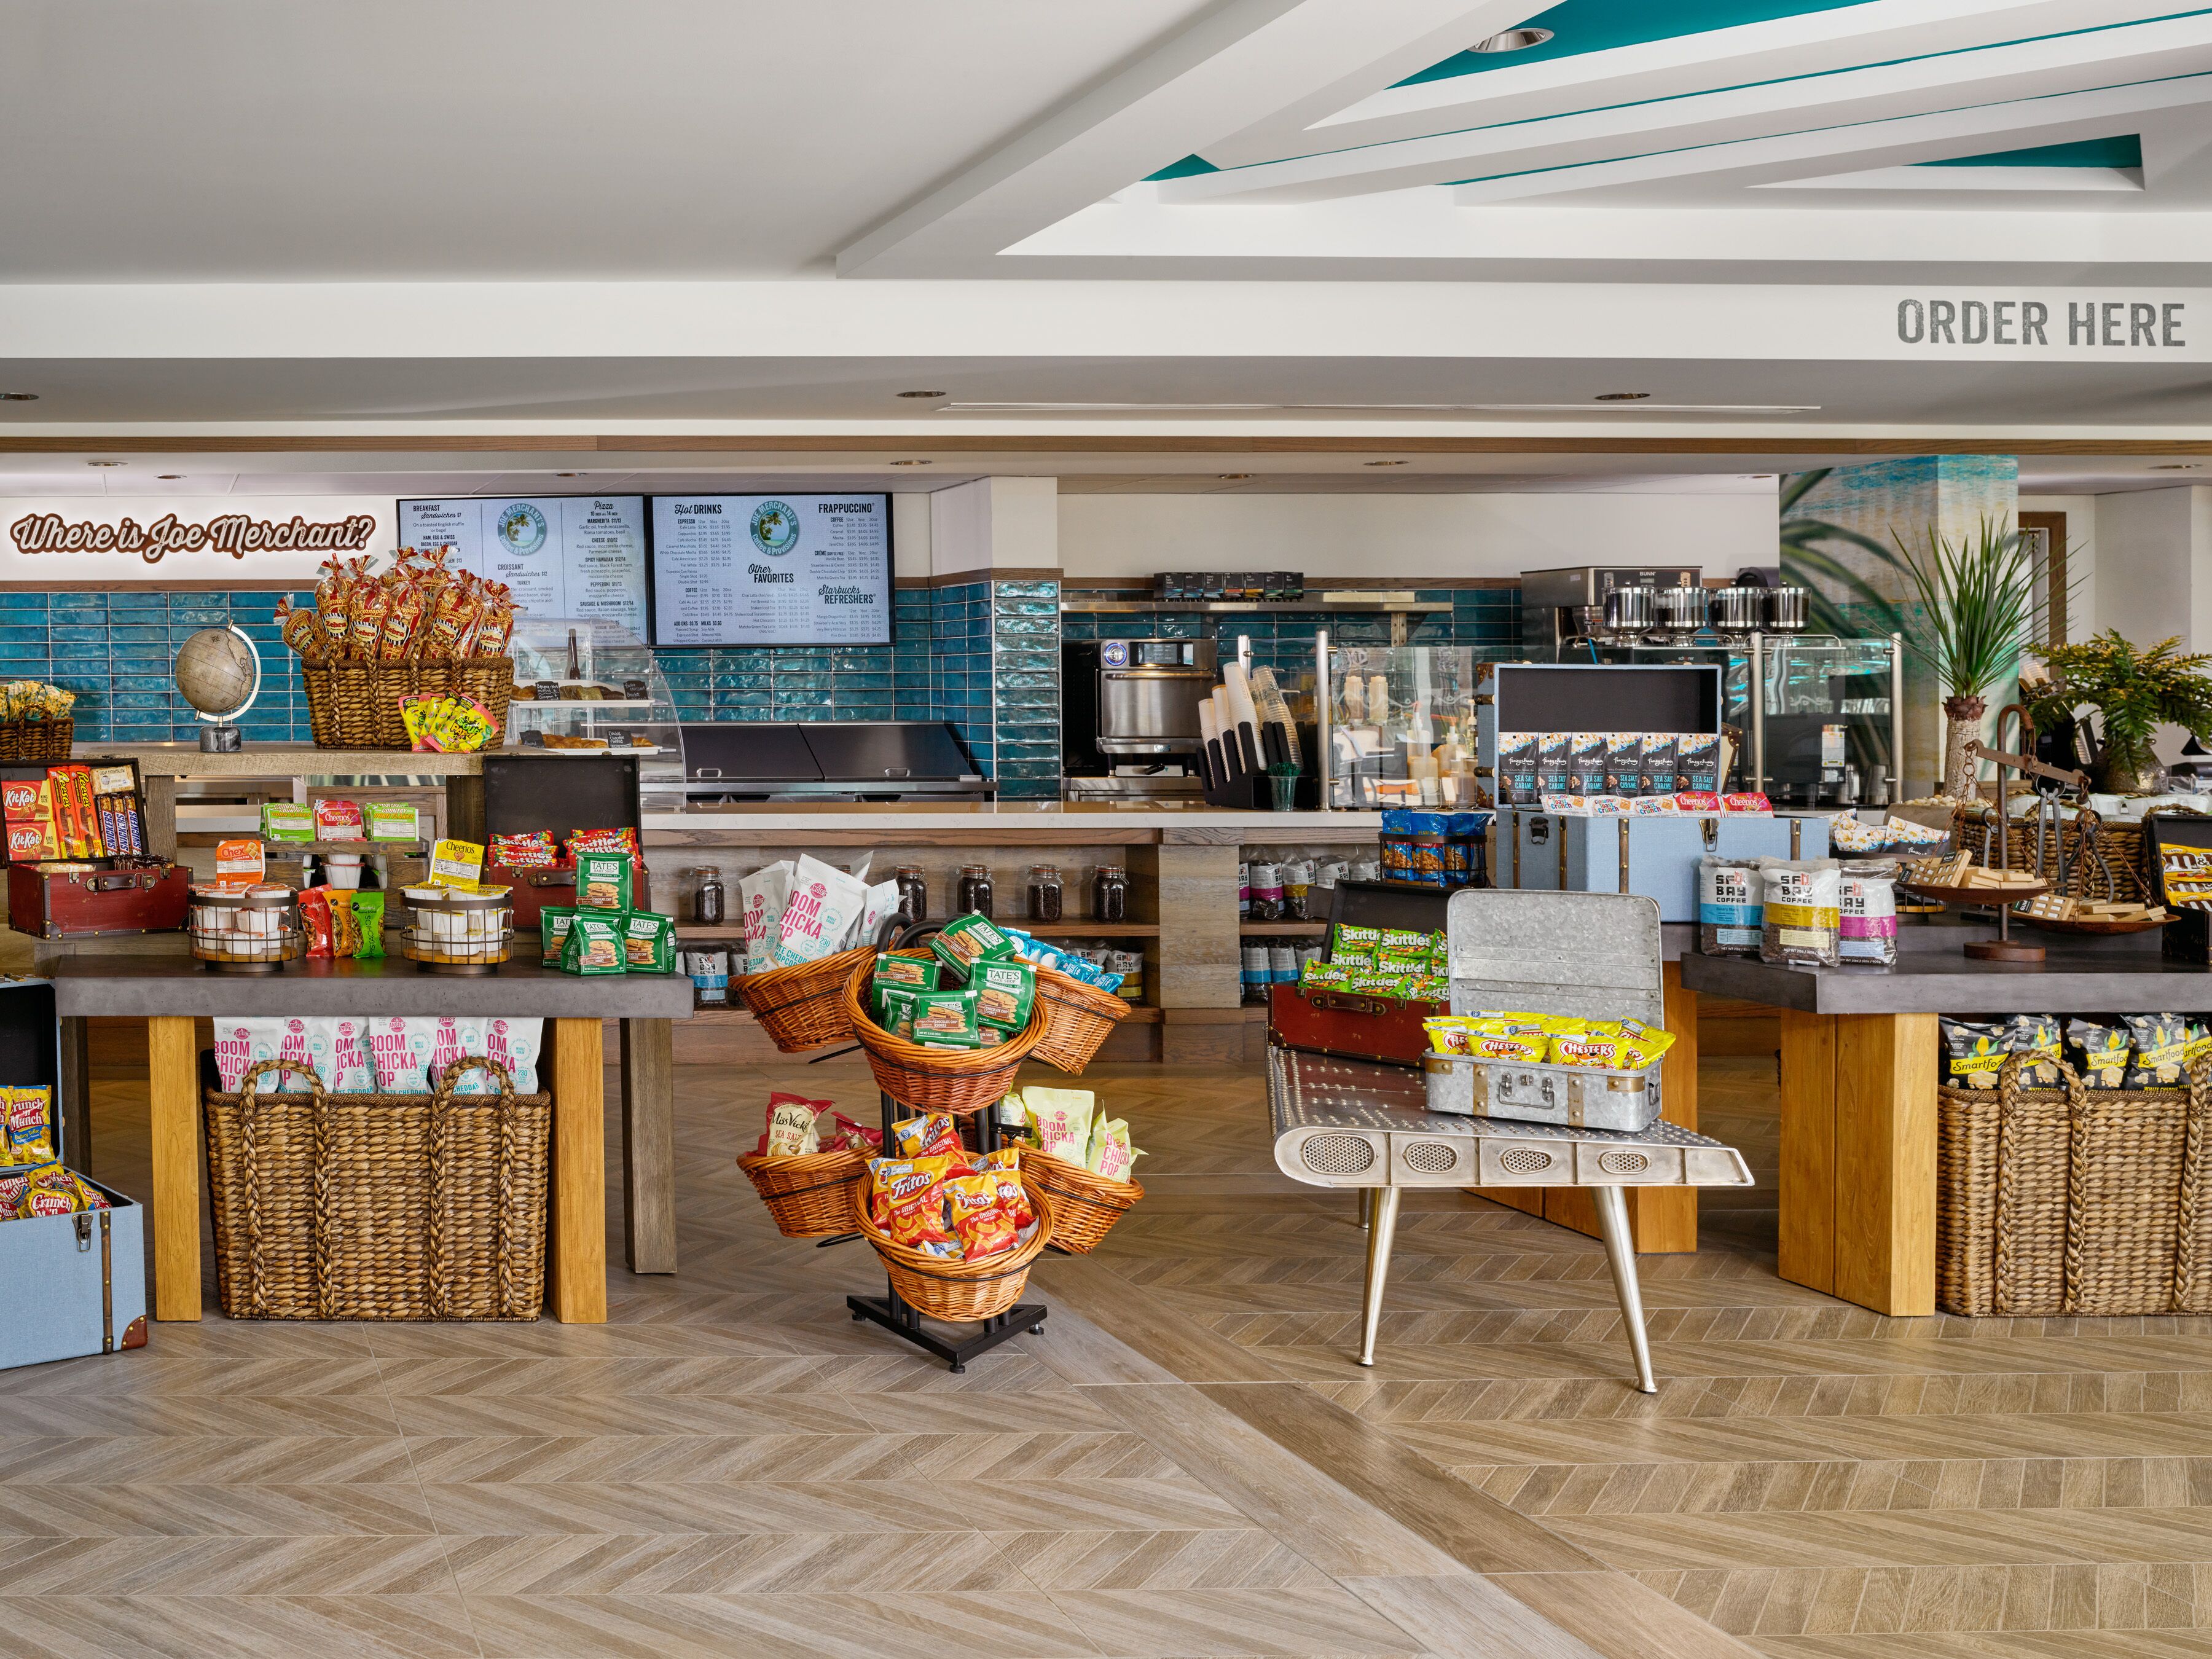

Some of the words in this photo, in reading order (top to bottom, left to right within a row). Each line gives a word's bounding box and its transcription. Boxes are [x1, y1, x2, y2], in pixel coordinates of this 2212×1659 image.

[1897, 298, 2049, 345] ORDER
[2068, 302, 2186, 347] HERE
[594, 501, 614, 509] Pizza
[675, 504, 693, 515] Hot
[694, 504, 722, 514] DRINKS
[498, 513, 508, 527] JOE
[506, 504, 544, 527] MERCHANT'S
[751, 512, 761, 526] JOE
[758, 501, 797, 527] MERCHANT'S
[14, 512, 114, 549] Where
[120, 517, 143, 549] is
[148, 514, 204, 560] Joe
[211, 515, 375, 555] Merchant?
[500, 535, 513, 552] Coffee
[519, 534, 544, 554] Provisions
[752, 534, 766, 552] Coffee
[772, 533, 796, 555] Provisions
[748, 563, 772, 574] Other
[754, 573, 794, 583] FAVORITES
[818, 584, 861, 597] Starbucks
[480, 634, 501, 644] Zebra
[104, 812, 116, 849] SNICKERS
[129, 811, 141, 849] SNICKERS
[222, 849, 245, 857] Chex
[446, 841, 475, 854] Cheerios
[1716, 875, 1735, 884] SF
[1781, 875, 1801, 884] SF
[1716, 886, 1746, 896] BAY
[365, 915, 375, 954] PISTACHIOS
[1381, 933, 1431, 947] Skittles
[989, 970, 1019, 979] TATE'S
[1560, 1041, 1617, 1058] CHESTER'S
[2143, 1046, 2184, 1065] Smartfood
[10, 1114, 43, 1130] Munch
[1037, 1116, 1066, 1131] BOOM
[15, 1131, 28, 1140] Buttery
[775, 1130, 784, 1139] SEA
[786, 1132, 801, 1140] SALT
[1100, 1160, 1119, 1177] POP
[891, 1173, 931, 1200] Fritos
[33, 1193, 71, 1211] Crunch
